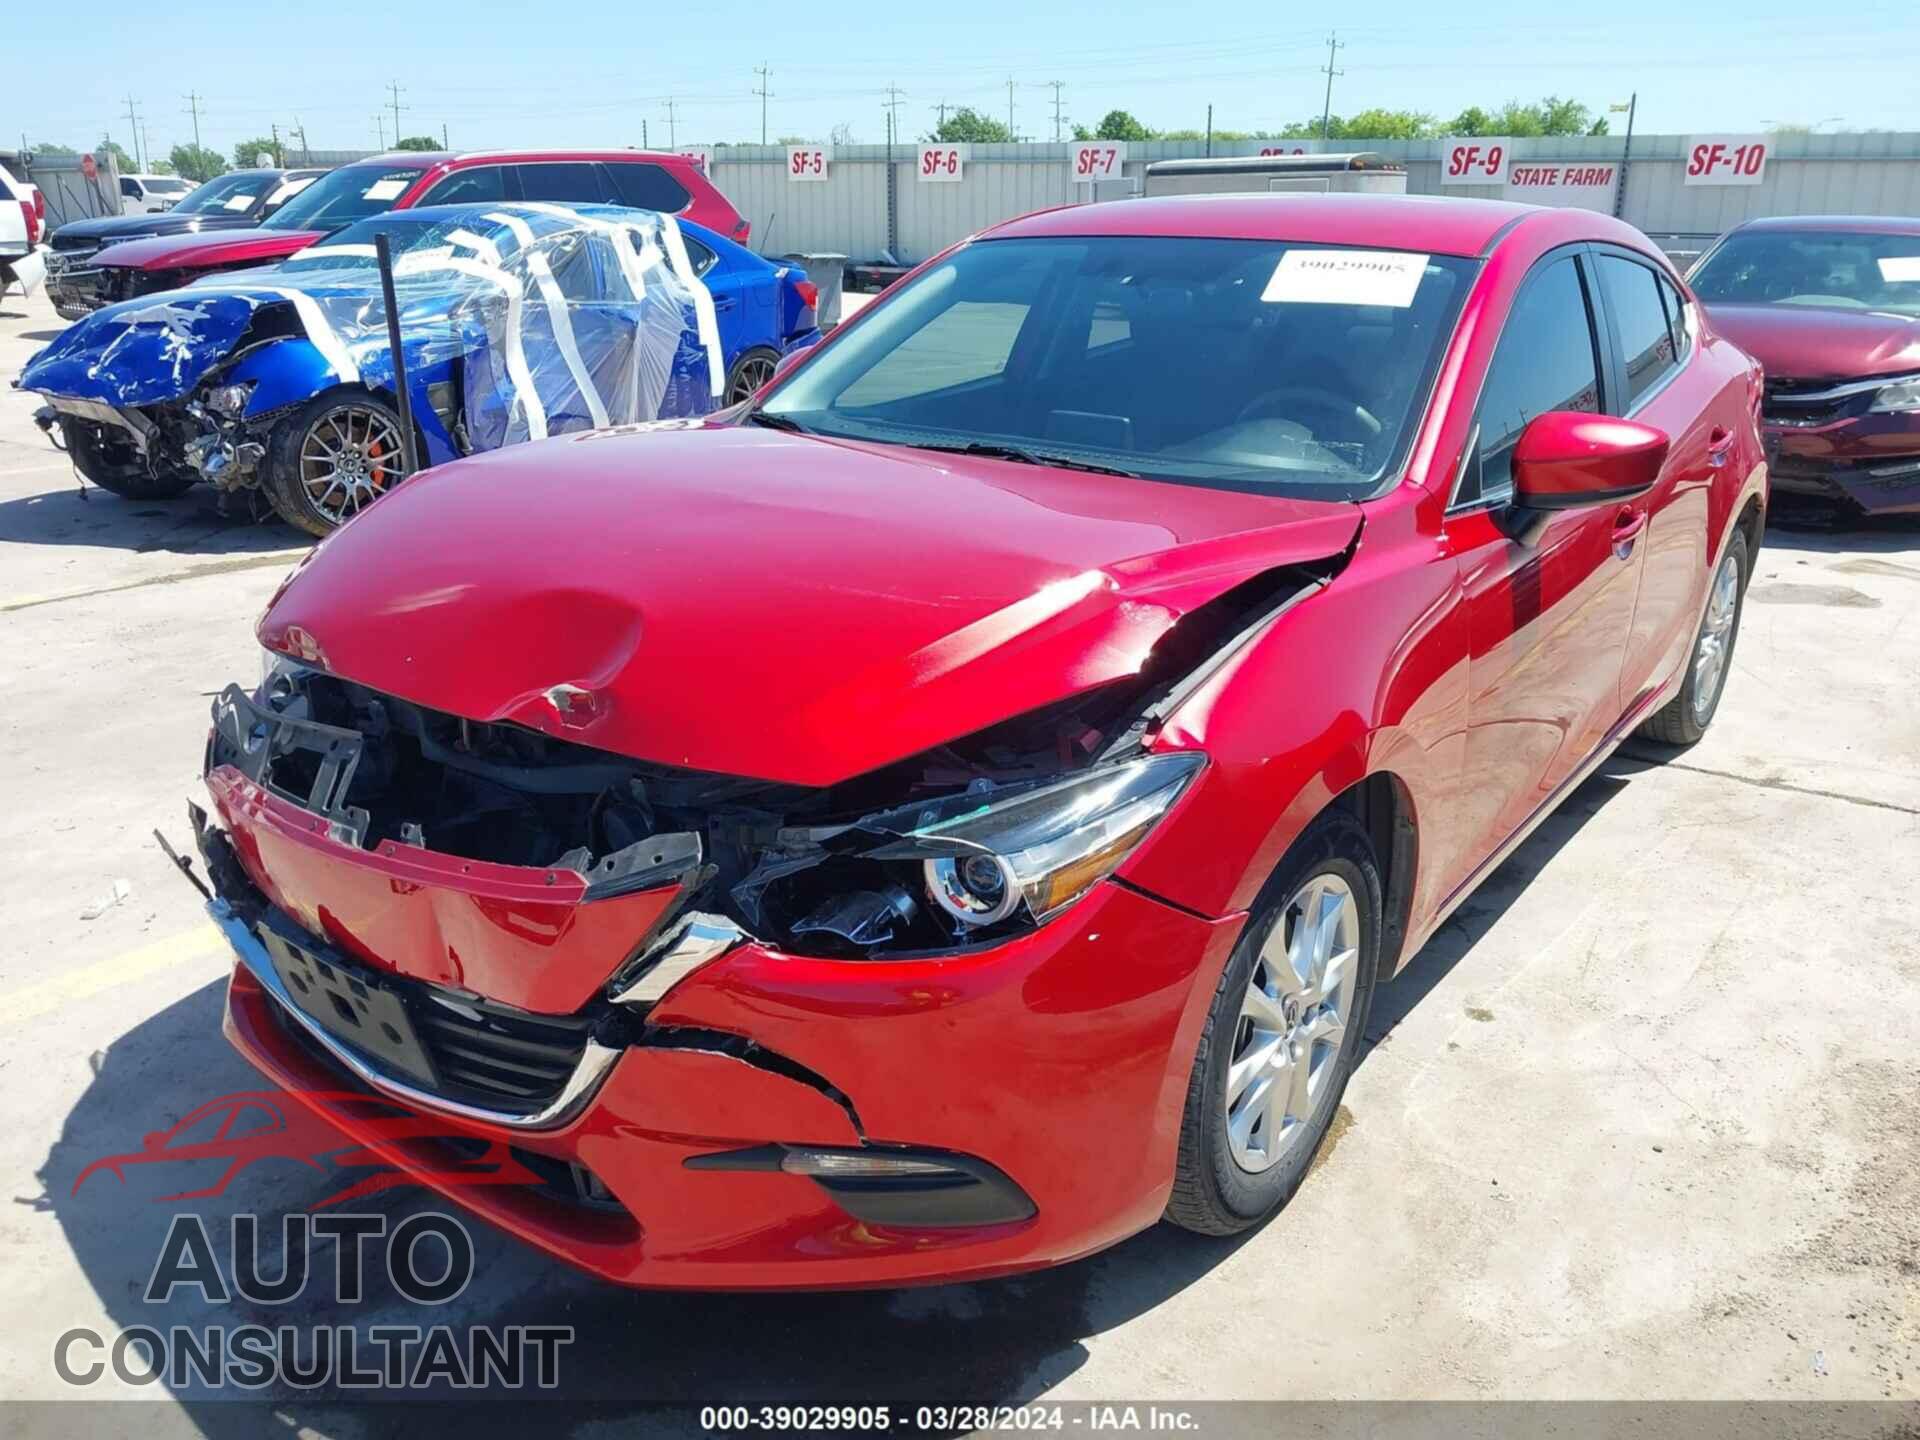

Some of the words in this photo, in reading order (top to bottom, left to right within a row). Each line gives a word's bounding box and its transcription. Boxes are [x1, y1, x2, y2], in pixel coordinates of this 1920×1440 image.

[792, 151, 822, 174] SF-5
[922, 150, 958, 175] SF-6
[1077, 148, 1116, 174] SF-7
[1448, 146, 1504, 176] SF-9
[1688, 144, 1765, 176] SF-10
[1511, 168, 1561, 186] STATE
[1562, 168, 1613, 186] FARM
